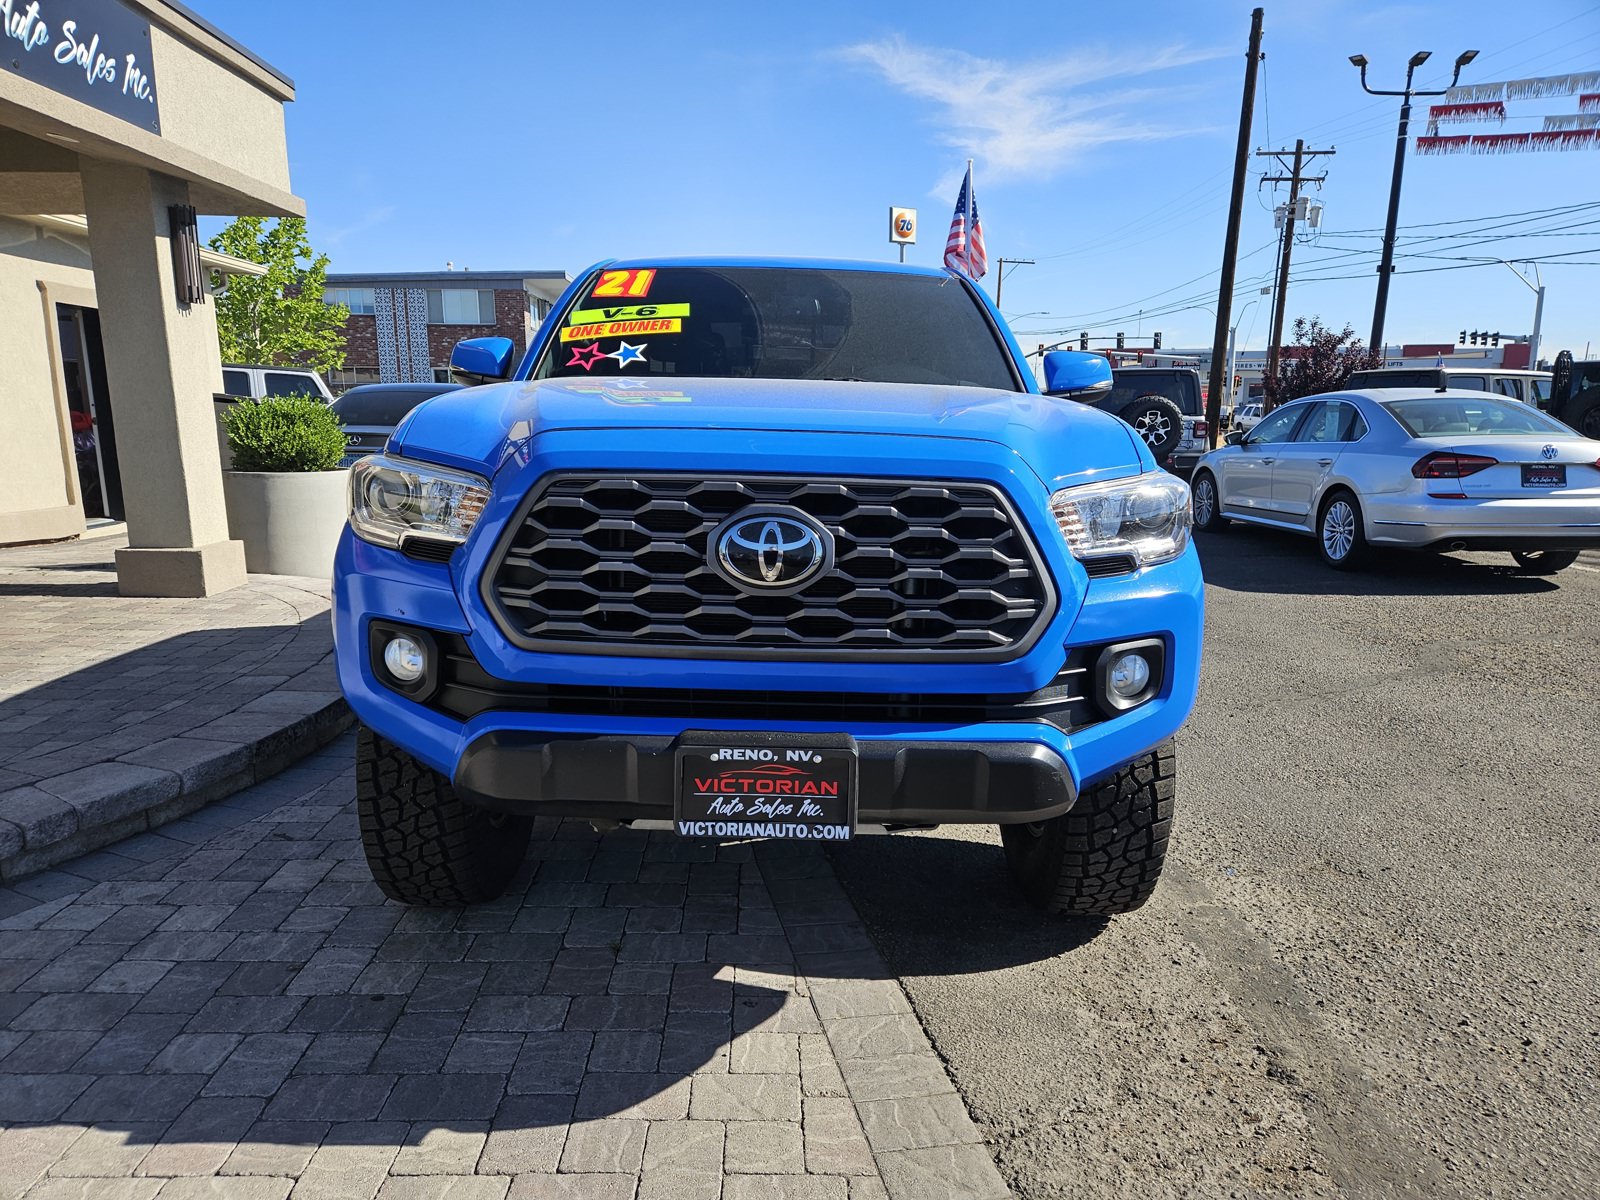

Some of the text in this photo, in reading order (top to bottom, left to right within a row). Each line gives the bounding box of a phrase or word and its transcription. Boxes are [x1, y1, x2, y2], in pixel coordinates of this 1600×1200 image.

[54, 20, 117, 85] Sales
[122, 53, 154, 103] Inc.
[899, 219, 913, 232] 76
[594, 269, 652, 296] 21
[602, 306, 658, 319] V-6
[568, 319, 672, 338] ONE OWNER
[719, 748, 814, 762] RENO, NV
[694, 777, 839, 795] VICTORIAN
[706, 796, 824, 819] Auto Sales Inc.
[678, 821, 850, 840] VICTORIANAUTO.COM
